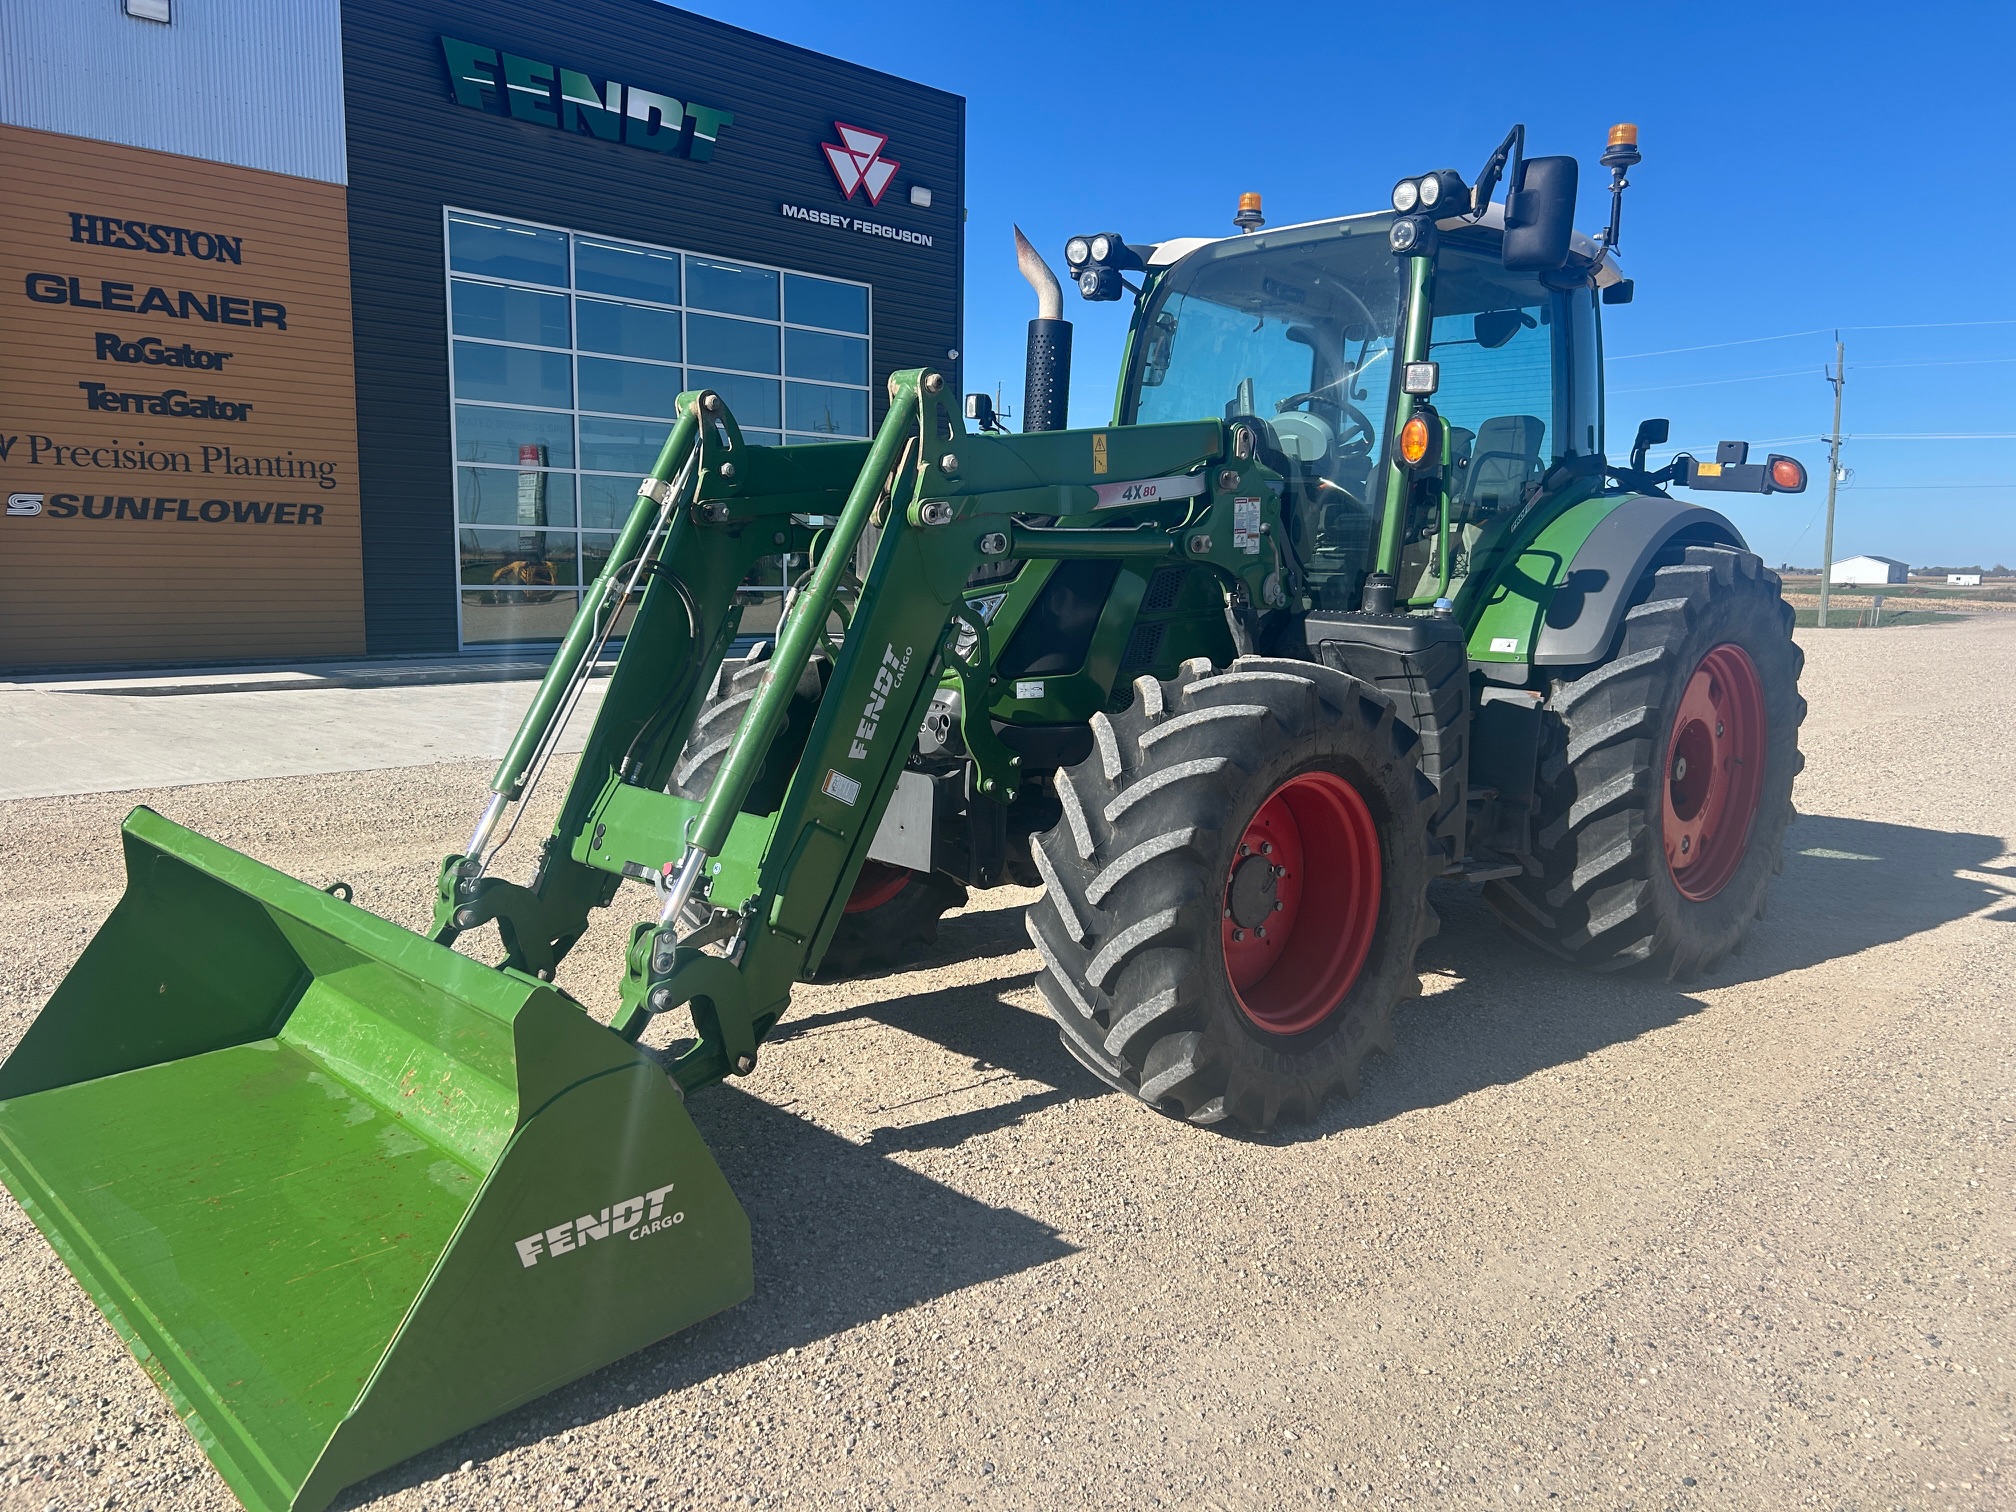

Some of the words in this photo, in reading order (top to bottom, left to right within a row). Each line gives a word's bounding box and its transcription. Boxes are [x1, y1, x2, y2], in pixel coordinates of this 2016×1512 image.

[440, 35, 735, 163] FENDT
[68, 211, 243, 265] HESSTON
[782, 203, 851, 229] MASSEY
[853, 219, 933, 247] FERGUSON
[25, 272, 288, 331] GLEANER
[95, 331, 233, 371] RoGator
[79, 381, 253, 422] TerraGator
[26, 434, 192, 472] Precision
[199, 445, 338, 490] Planting
[47, 493, 325, 526] SUNFLOWER
[893, 646, 913, 689] CARGO
[848, 642, 900, 760] FENDT
[515, 1183, 675, 1269] FENDT
[629, 1211, 685, 1241] CARGO
